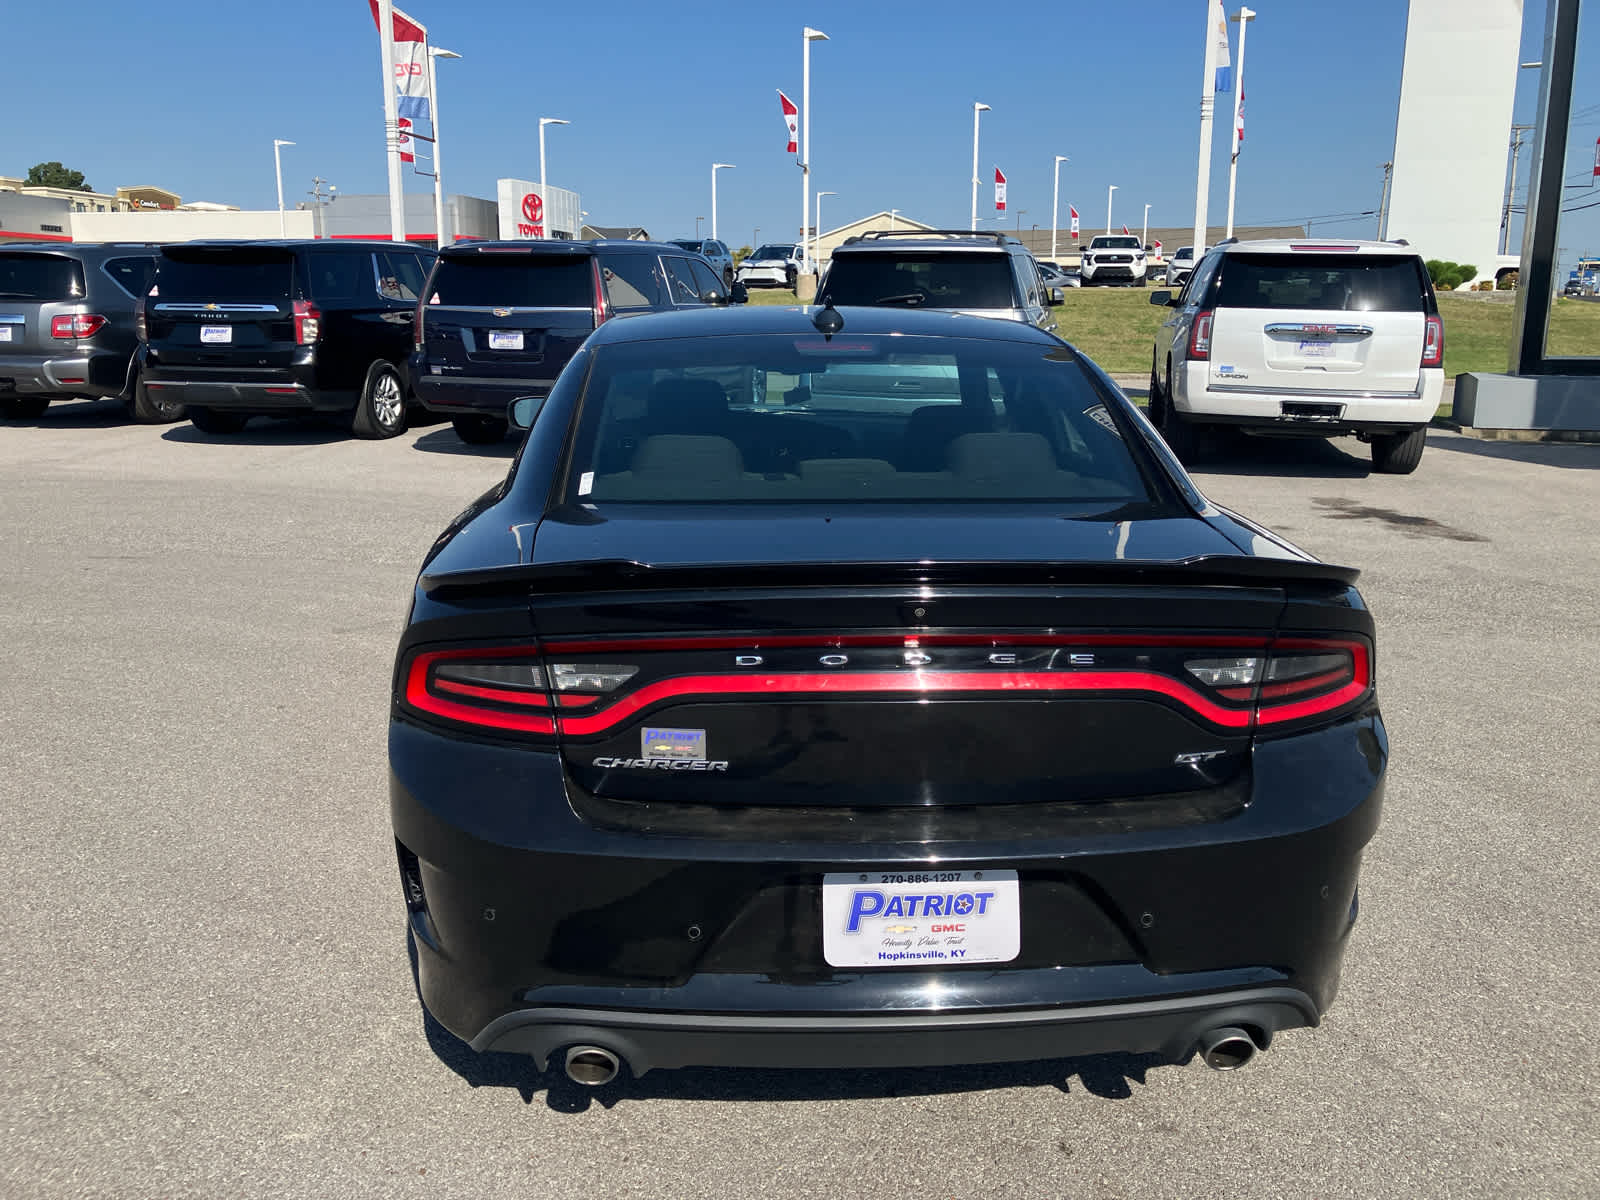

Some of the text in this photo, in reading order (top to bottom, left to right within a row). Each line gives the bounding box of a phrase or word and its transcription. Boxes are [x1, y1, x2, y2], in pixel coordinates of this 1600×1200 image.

[518, 223, 544, 237] TOYOT
[1302, 324, 1337, 334] GMC
[735, 652, 1095, 666] DODGE
[645, 729, 702, 744] PATRIOT
[592, 756, 729, 771] CHARGER
[1174, 750, 1227, 764] GT
[881, 872, 962, 884] 270-886-1207
[845, 889, 996, 934] PATRIOT
[931, 923, 966, 933] GMC
[878, 950, 948, 961] Hopkinsville,
[950, 948, 967, 959] KY
